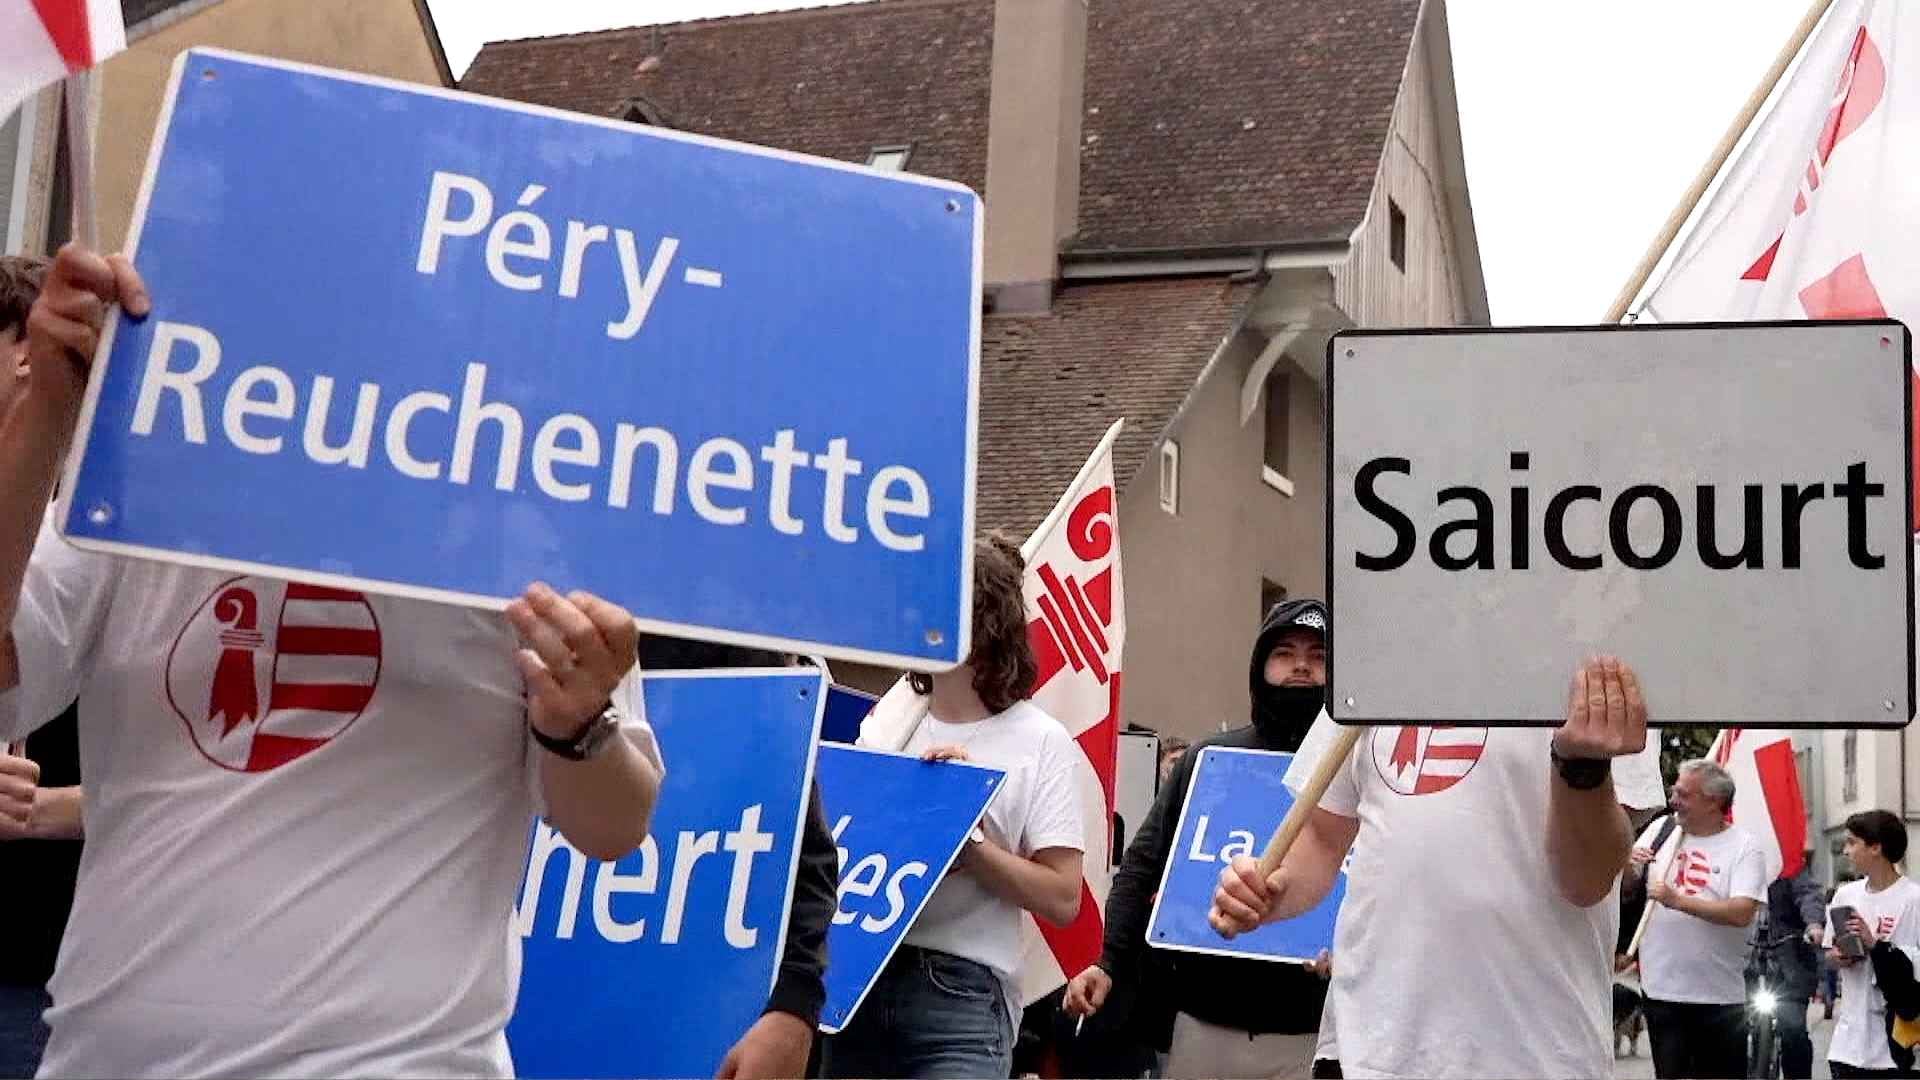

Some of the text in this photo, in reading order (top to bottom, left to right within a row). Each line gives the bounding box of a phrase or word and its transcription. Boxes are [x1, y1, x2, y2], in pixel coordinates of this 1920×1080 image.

[415, 170, 723, 340] Péry-
[130, 320, 931, 552] Reuchenette
[1354, 451, 1886, 572] Saicourt
[1188, 814, 1256, 866] La
